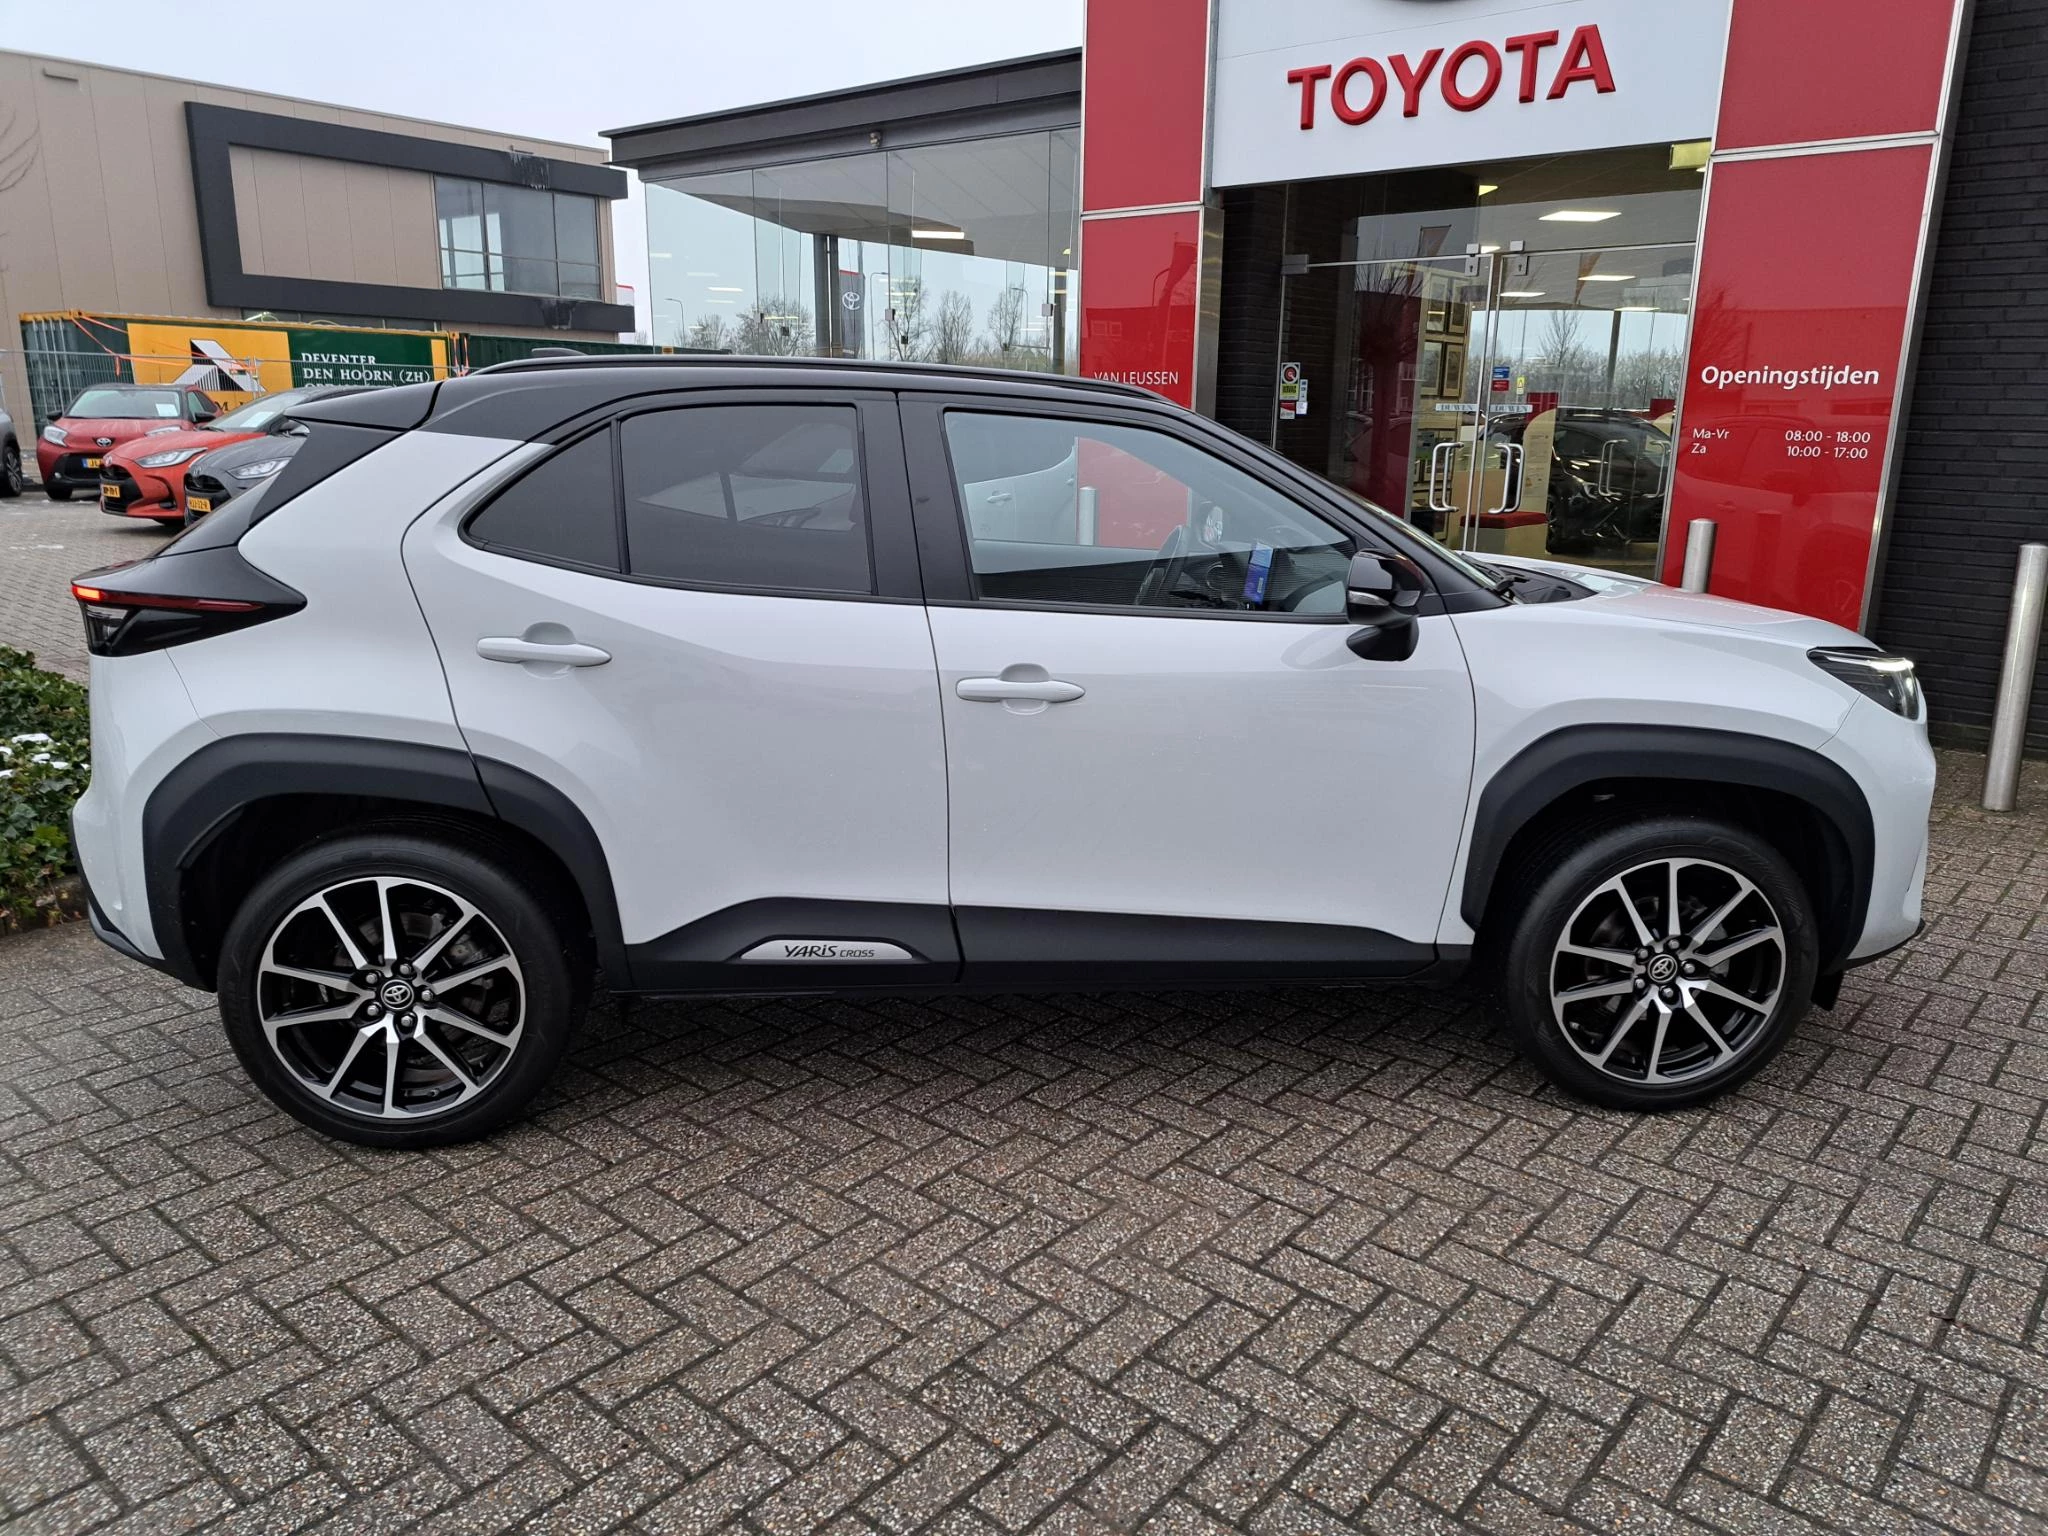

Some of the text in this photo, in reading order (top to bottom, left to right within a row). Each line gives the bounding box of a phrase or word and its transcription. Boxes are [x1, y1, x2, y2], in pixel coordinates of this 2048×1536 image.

[1287, 23, 1617, 131] TOYOTA
[301, 352, 377, 365] DEVENTER
[303, 368, 431, 384] DEN HOORN (ZH)
[1094, 371, 1179, 385] VAN LEUSSEN
[1701, 365, 1880, 390] Openingstijden
[1693, 428, 1730, 440] Ma-Vr
[1785, 429, 1823, 442] 08:00
[1836, 430, 1871, 444] 18:00
[1691, 443, 1707, 454] Za
[1786, 446, 1821, 457] 10:00
[1833, 447, 1869, 459] 17:00
[839, 949, 875, 958] CROSS
